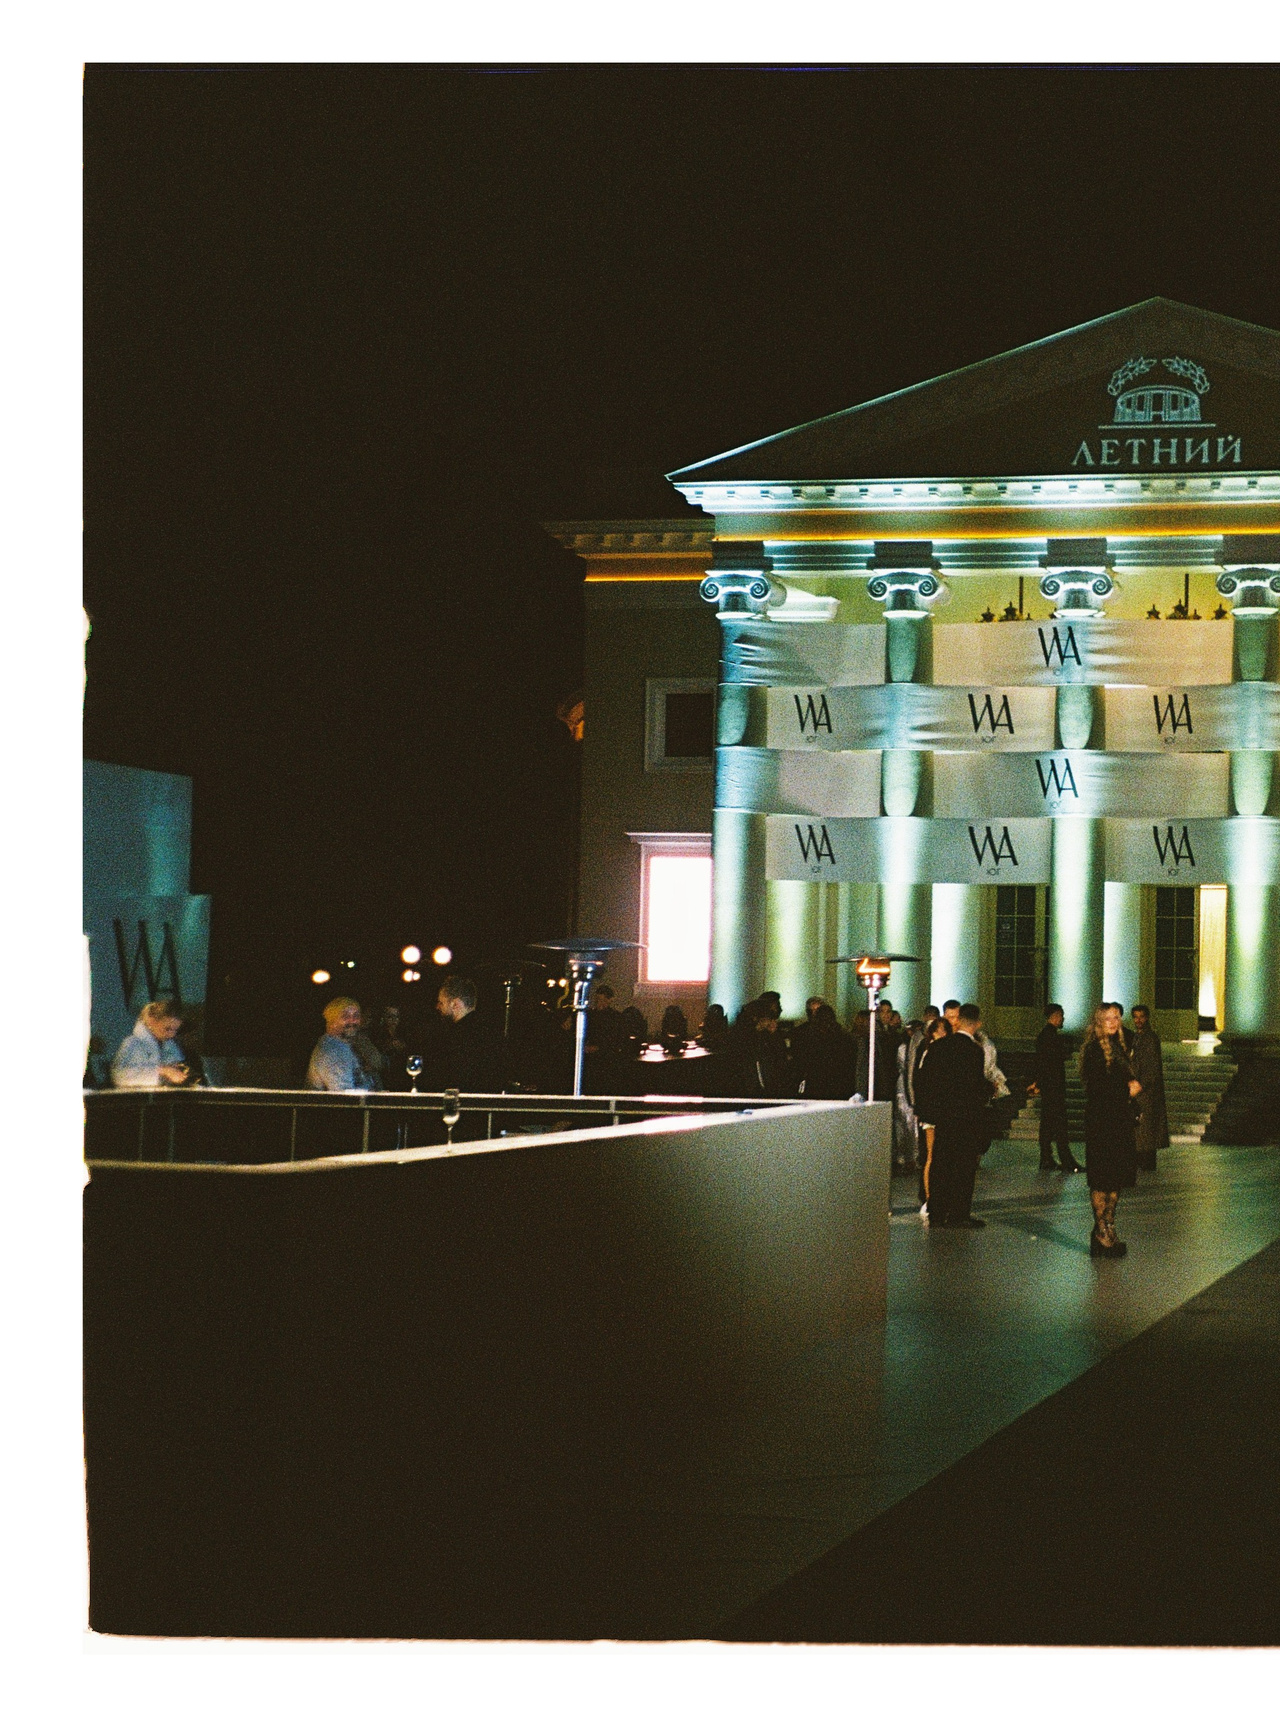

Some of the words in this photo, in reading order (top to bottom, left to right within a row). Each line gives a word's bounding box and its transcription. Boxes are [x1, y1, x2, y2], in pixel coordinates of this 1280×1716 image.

[1071, 435, 1242, 465] ЛЕТНИЙ
[1037, 626, 1082, 667] WA
[794, 694, 833, 734] WA
[967, 693, 1015, 734] WA
[1153, 693, 1193, 734] WA
[1035, 759, 1079, 798] WA
[795, 824, 836, 865] WA
[968, 826, 1019, 866] WA
[1153, 826, 1196, 867] WA
[113, 917, 182, 1010] WA
